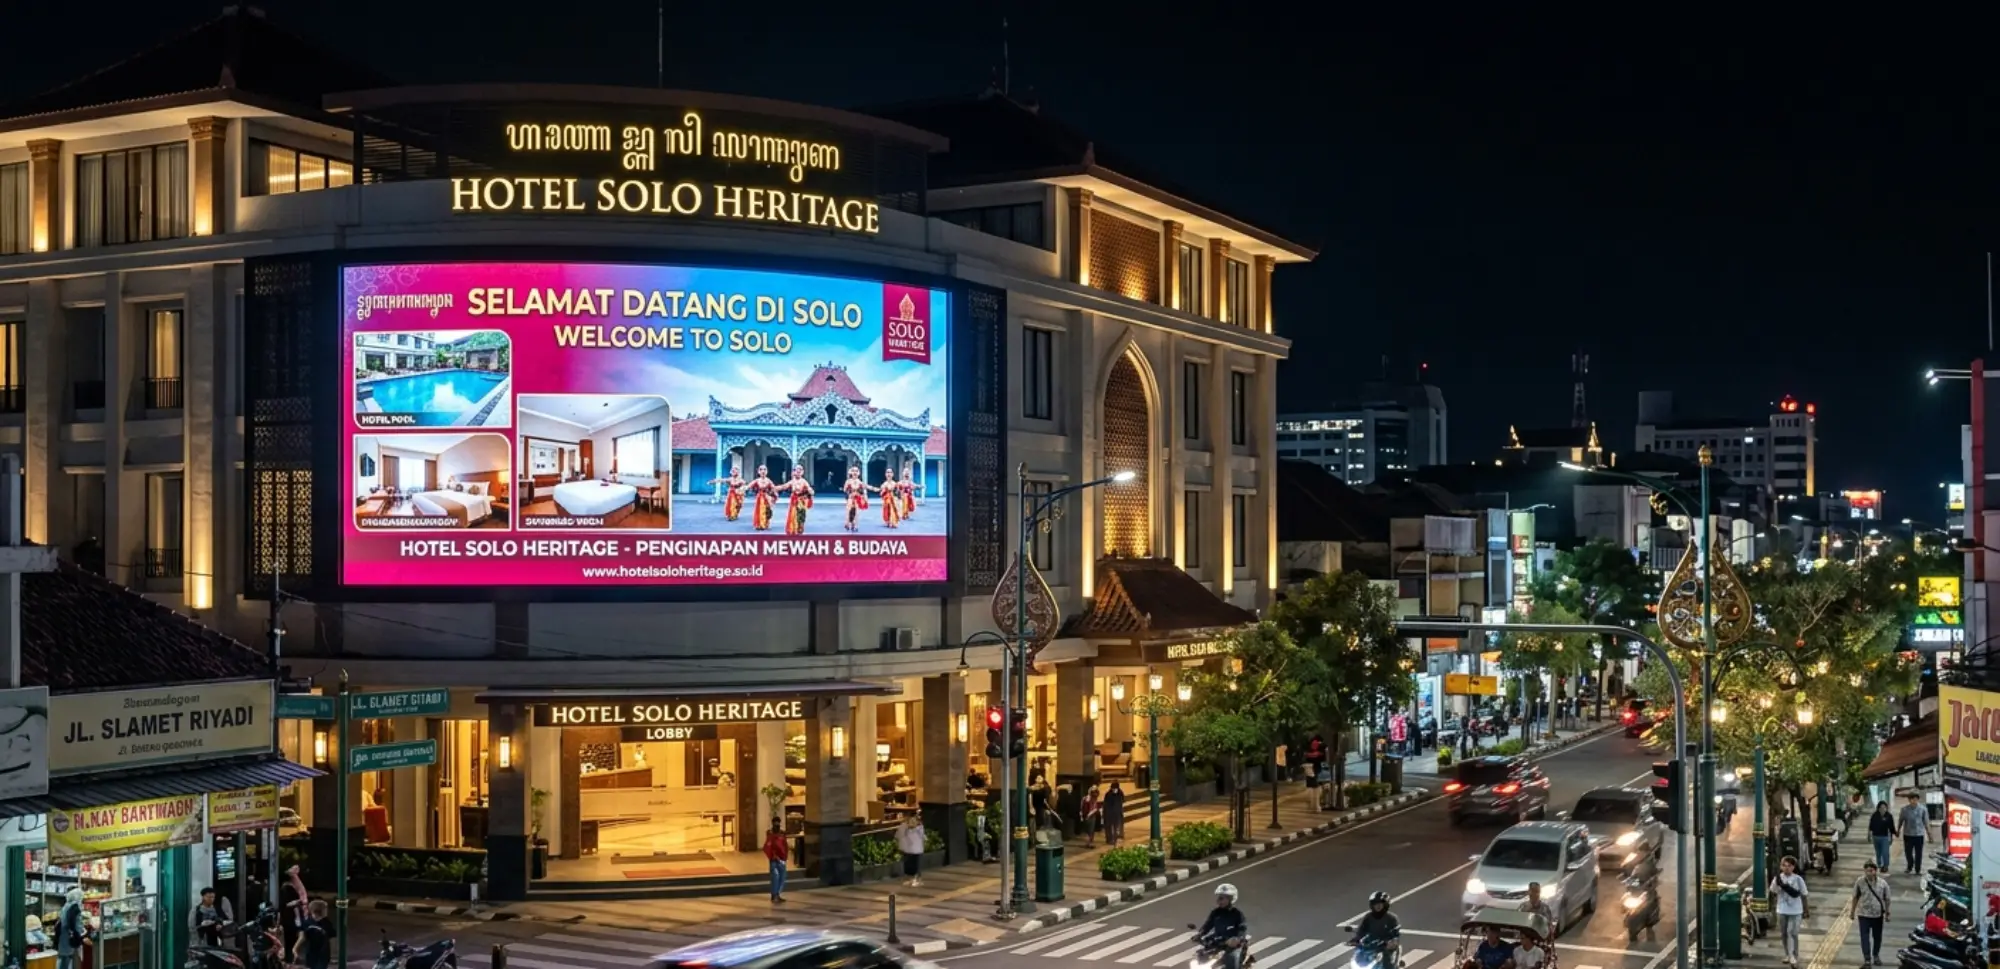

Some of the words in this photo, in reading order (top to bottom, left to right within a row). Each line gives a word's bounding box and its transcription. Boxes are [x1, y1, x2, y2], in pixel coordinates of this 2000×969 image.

[451, 177, 586, 210] HOTEL
[597, 178, 703, 214] SOLO
[713, 184, 880, 233] HERITAGE
[468, 288, 615, 315] SELAMAT
[623, 289, 747, 321] DATANG
[756, 295, 785, 323] DI
[793, 298, 862, 329] SOLO
[554, 325, 684, 349] WELCOME
[690, 328, 723, 351] TO
[730, 330, 792, 353] SOLO
[888, 321, 926, 340] SOLO
[400, 540, 461, 556] HOTEL
[466, 540, 517, 556] SOLO
[523, 540, 619, 556] HERITAGE
[636, 540, 758, 556] PENGINAPAN
[763, 540, 829, 556] MEWAH
[833, 540, 845, 555] &
[849, 540, 908, 556] BUDAYA
[64, 721, 94, 744] JL.
[101, 712, 184, 740] SLAMET
[189, 705, 254, 731] RIYADI
[552, 706, 626, 724] HOTEL
[632, 704, 692, 722] SOLO
[699, 701, 802, 720] HERITAGE
[646, 727, 694, 740] LOBBY
